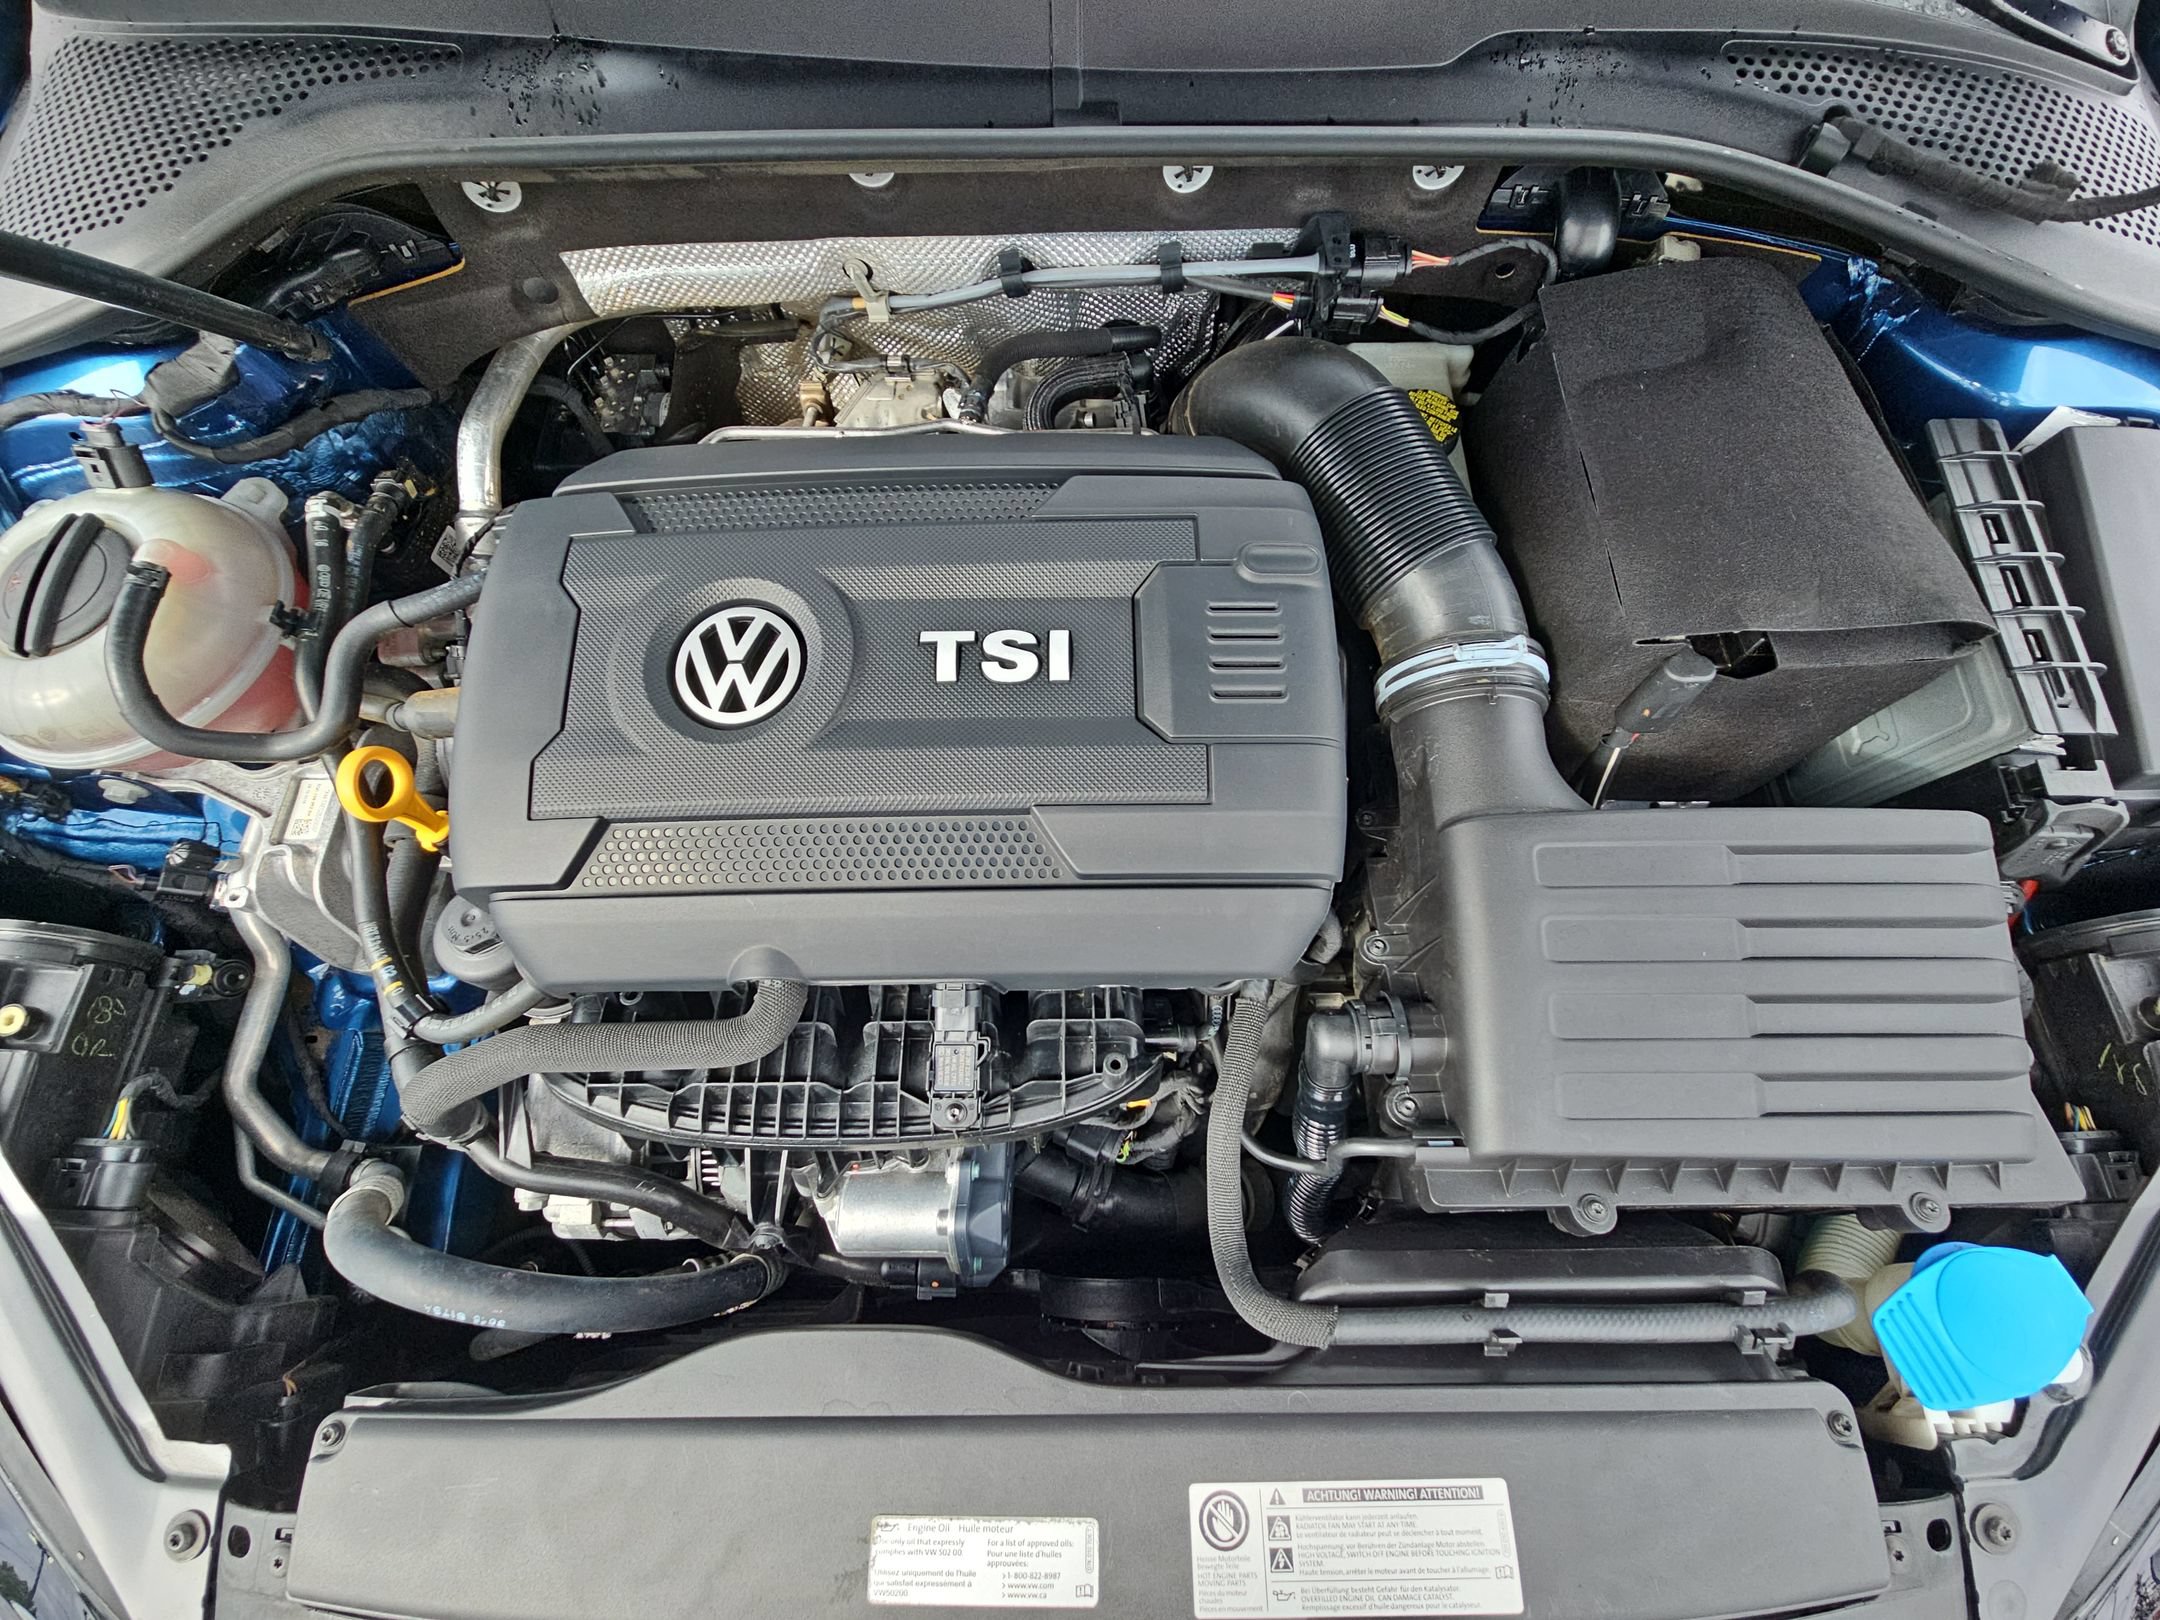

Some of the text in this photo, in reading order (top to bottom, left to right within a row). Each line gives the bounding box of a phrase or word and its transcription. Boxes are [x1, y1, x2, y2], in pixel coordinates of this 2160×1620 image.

[919, 629, 1072, 684] TSI
[674, 606, 801, 724] VW
[1307, 1487, 1480, 1501] ACHTUNG! WARNING! ATTENTION!
[907, 1523, 1014, 1535] Engine Oil Huile moteur
[1342, 1521, 1356, 1529] MAY
[1377, 1530, 1392, 1539] peut
[933, 1539, 964, 1548] expressly
[987, 1538, 999, 1547] For
[1005, 1538, 1016, 1547] list
[1017, 1538, 1026, 1547] of
[1027, 1539, 1059, 1549] approved
[987, 1550, 1003, 1558] Pour
[1019, 1550, 1034, 1558] liste
[1346, 1551, 1371, 1559] SWITCH
[1386, 1550, 1410, 1558] ENGINE
[1435, 1549, 1470, 1557] TOUCHING
[901, 1569, 944, 1578] uniquement
[1427, 1566, 1450, 1574] toucher
[1007, 1571, 1061, 1580] 1-800-822-8987
[967, 1580, 973, 1588] à
[1339, 1594, 1363, 1602] ENGINE
[1425, 1602, 1441, 1611] pour
